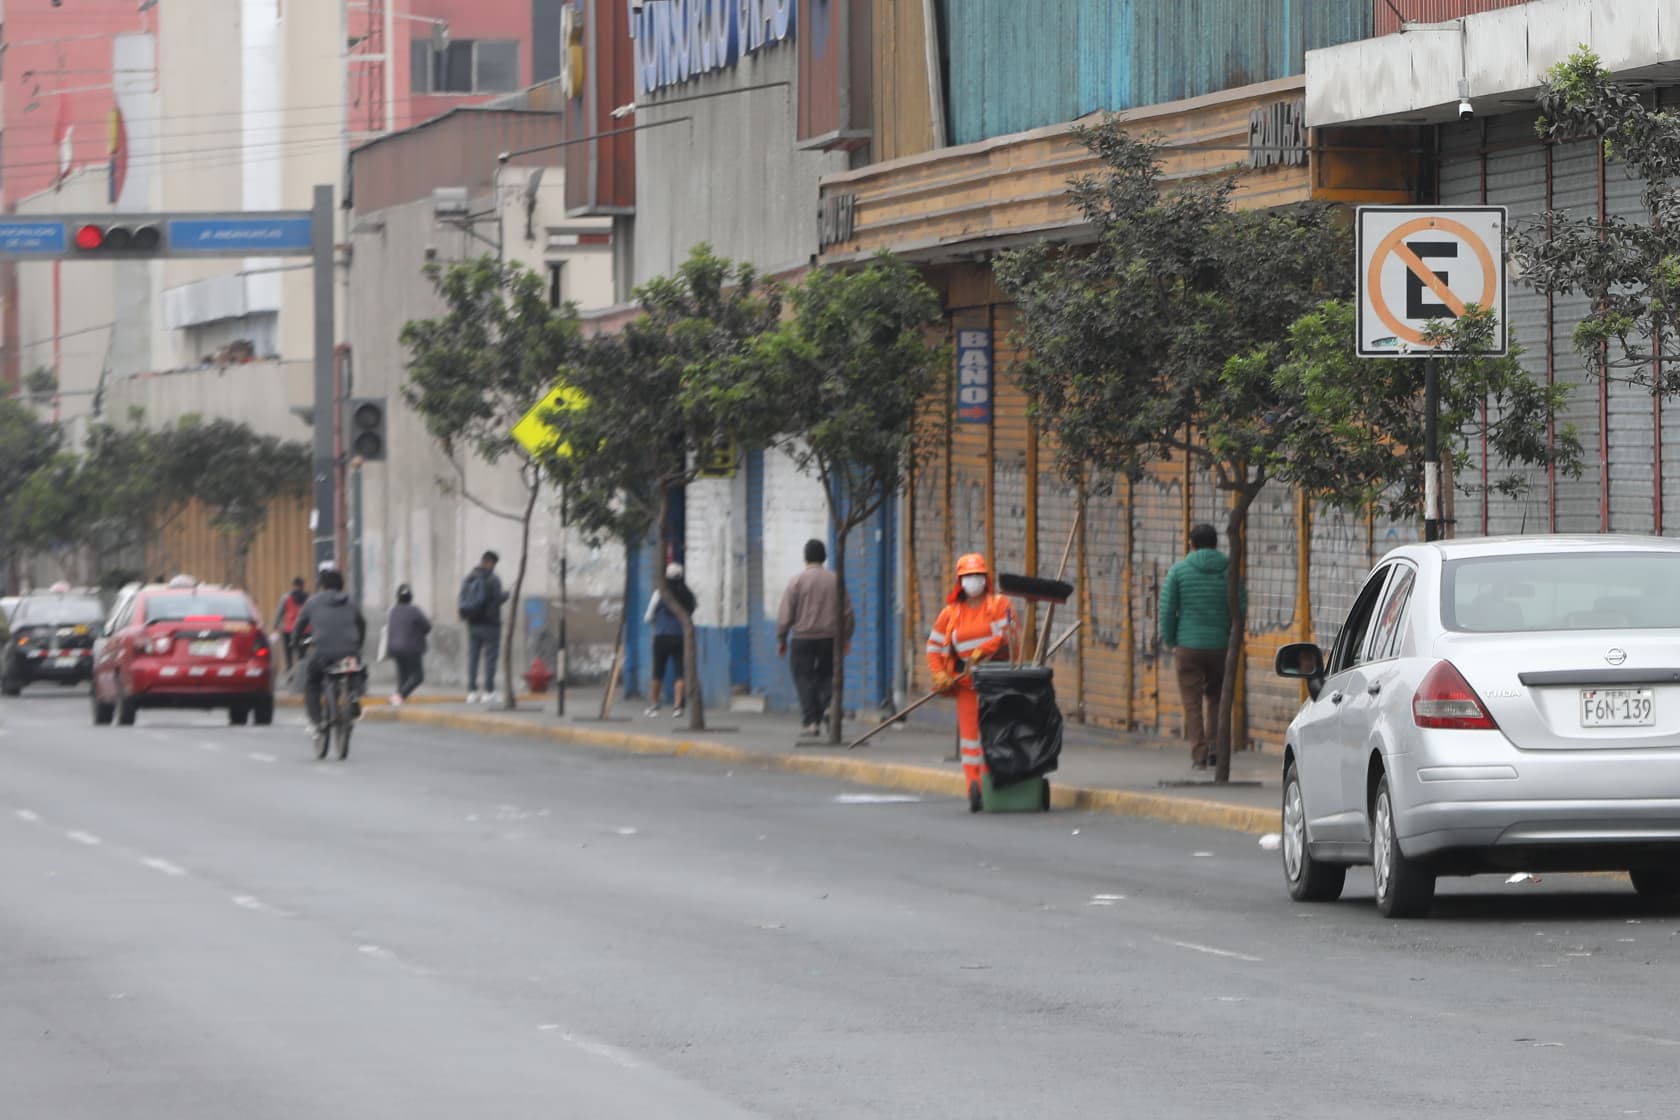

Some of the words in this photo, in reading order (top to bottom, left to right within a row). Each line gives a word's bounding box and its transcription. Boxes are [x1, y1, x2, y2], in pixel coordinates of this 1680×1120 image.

[959, 331, 989, 404] BAÑO
[1485, 689, 1521, 698] TIIDA
[1584, 699, 1651, 720] F6N-139
